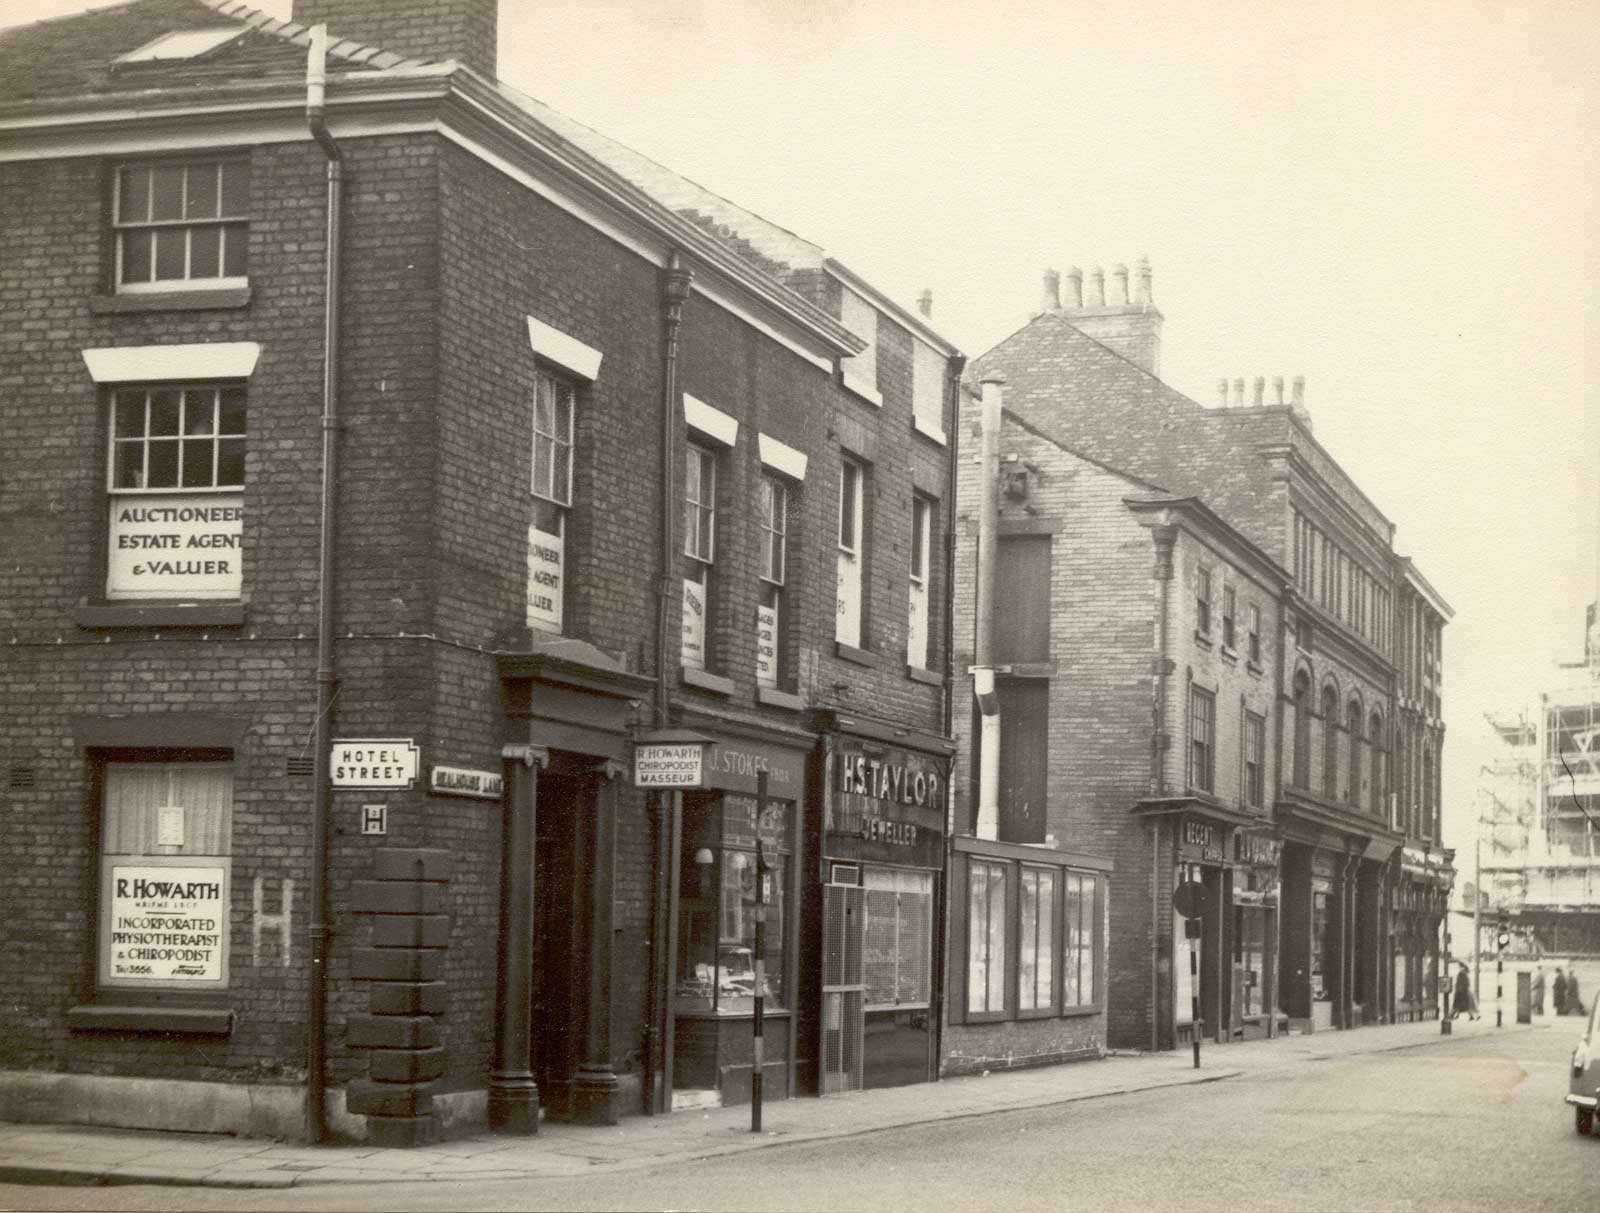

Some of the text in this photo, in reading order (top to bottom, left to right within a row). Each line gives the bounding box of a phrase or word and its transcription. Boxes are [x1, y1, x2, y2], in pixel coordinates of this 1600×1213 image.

[118, 534, 181, 549] ESTATE
[343, 750, 399, 763] HOTEL
[649, 748, 700, 759] HOWARTH
[638, 761, 699, 770] CHIROPODIST
[336, 766, 405, 780] STREET
[641, 773, 694, 784] MASSEUR
[133, 879, 220, 899] HOWARTH
[118, 917, 216, 931] INCORPORATED
[112, 932, 220, 946] PHYSIOTHERAPIST
[128, 948, 212, 961] CHIROPODIST
